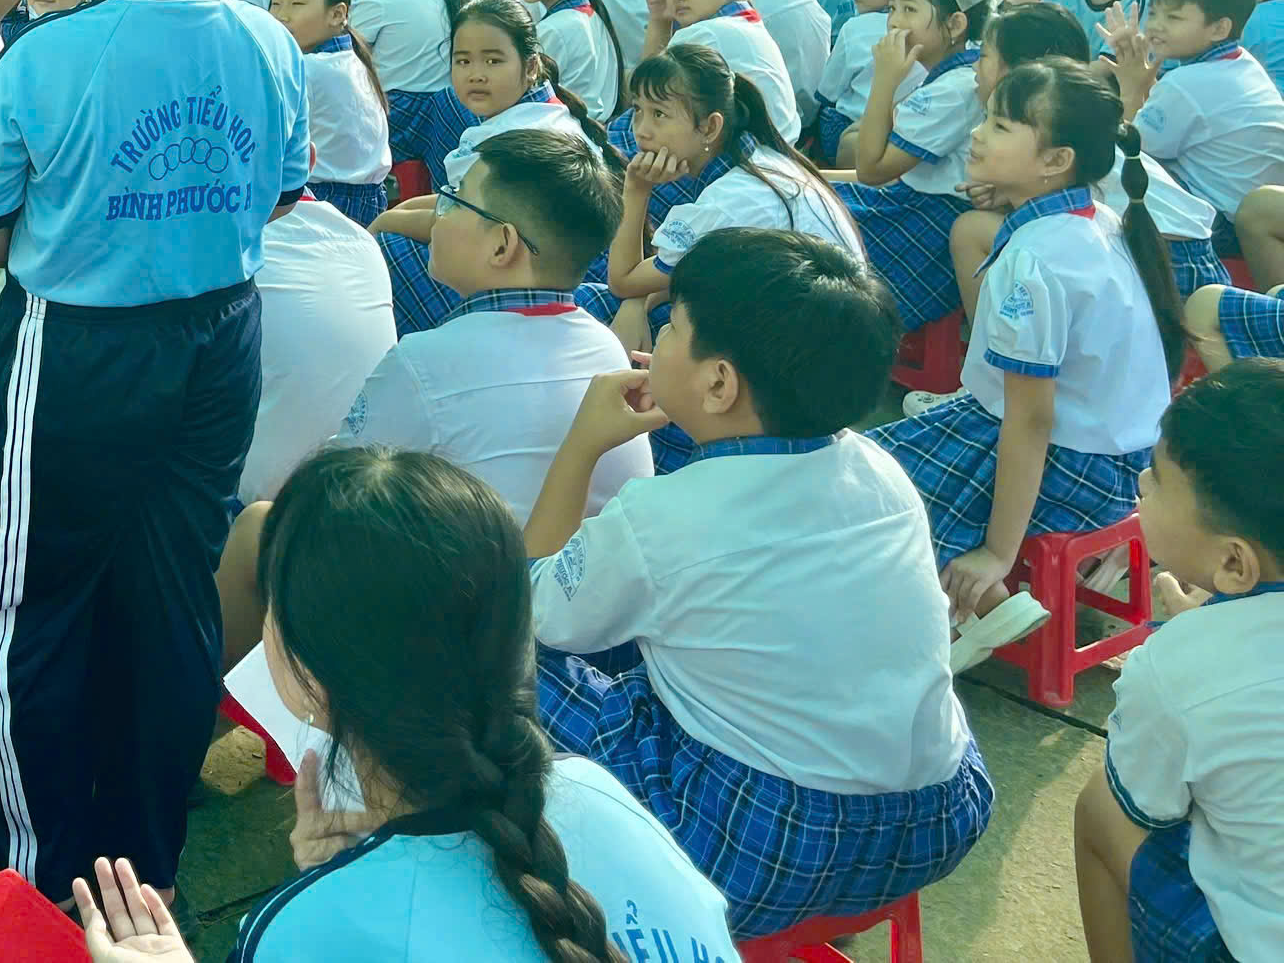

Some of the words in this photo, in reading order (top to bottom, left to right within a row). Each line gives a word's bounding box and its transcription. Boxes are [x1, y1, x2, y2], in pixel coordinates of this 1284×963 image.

[110, 100, 181, 173] TRƯỜNG
[187, 85, 228, 131] TIỂU
[227, 114, 256, 164] HỌC
[106, 186, 164, 221] BÌNH
[166, 178, 241, 219] PHƯỚC
